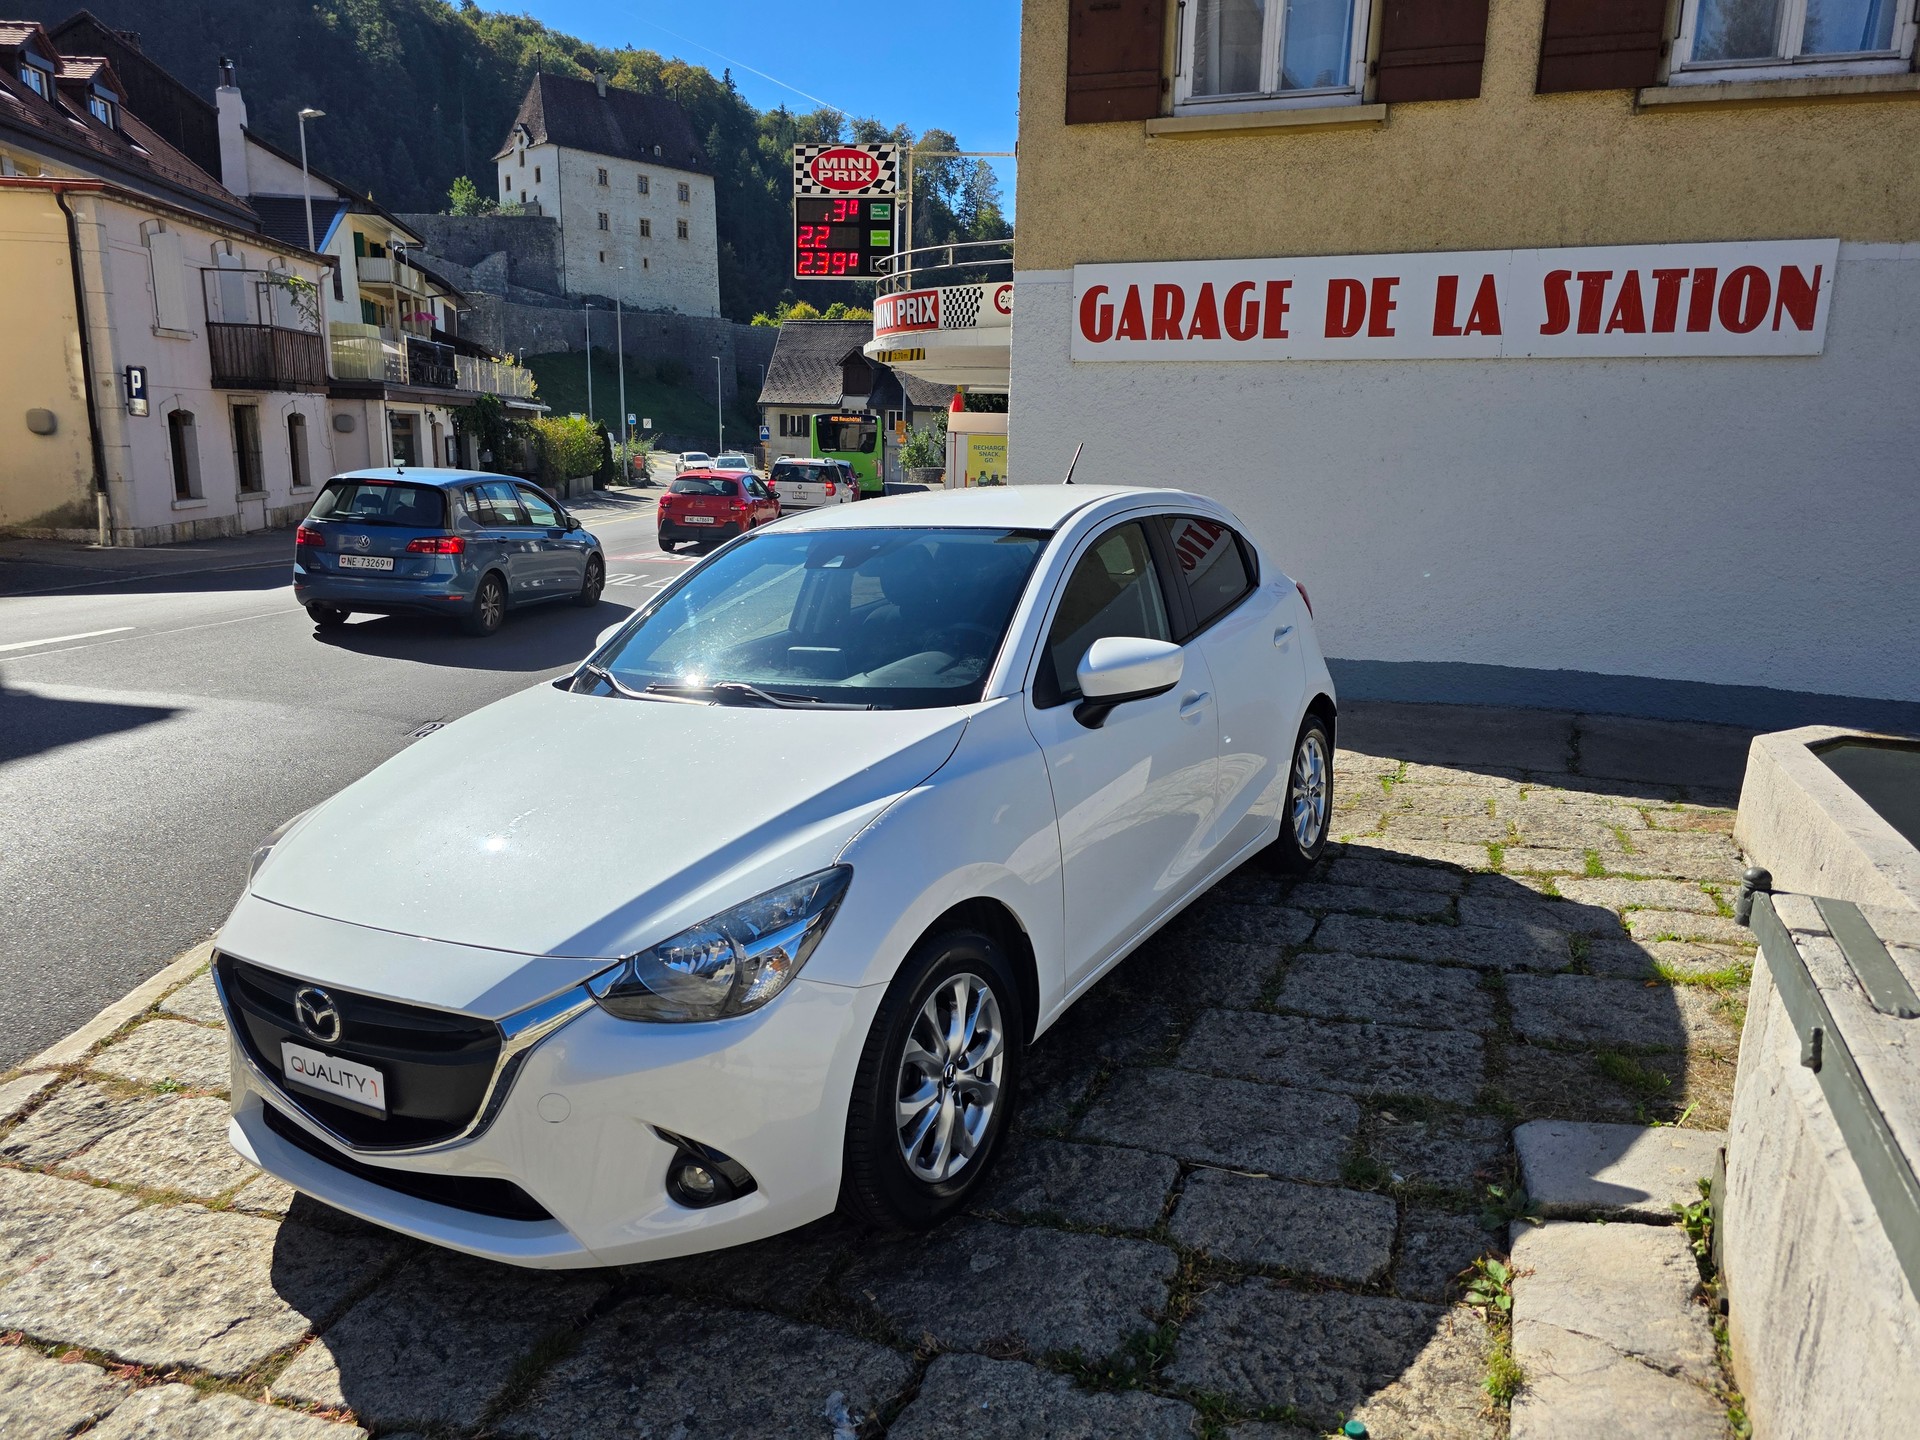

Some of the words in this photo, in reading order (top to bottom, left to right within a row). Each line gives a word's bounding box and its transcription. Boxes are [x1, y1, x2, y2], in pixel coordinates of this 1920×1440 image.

[818, 157, 872, 169] MINI
[818, 170, 873, 182] PRIX
[876, 301, 894, 330] MINI
[896, 295, 937, 327] PRIX
[1080, 281, 1291, 342] GARAGE
[1326, 278, 1400, 338] DE
[1434, 275, 1501, 336] LA
[1541, 266, 1821, 335] STATION
[131, 370, 142, 397] P
[290, 1055, 367, 1093] QUALITY
[370, 1080, 378, 1098] 1
